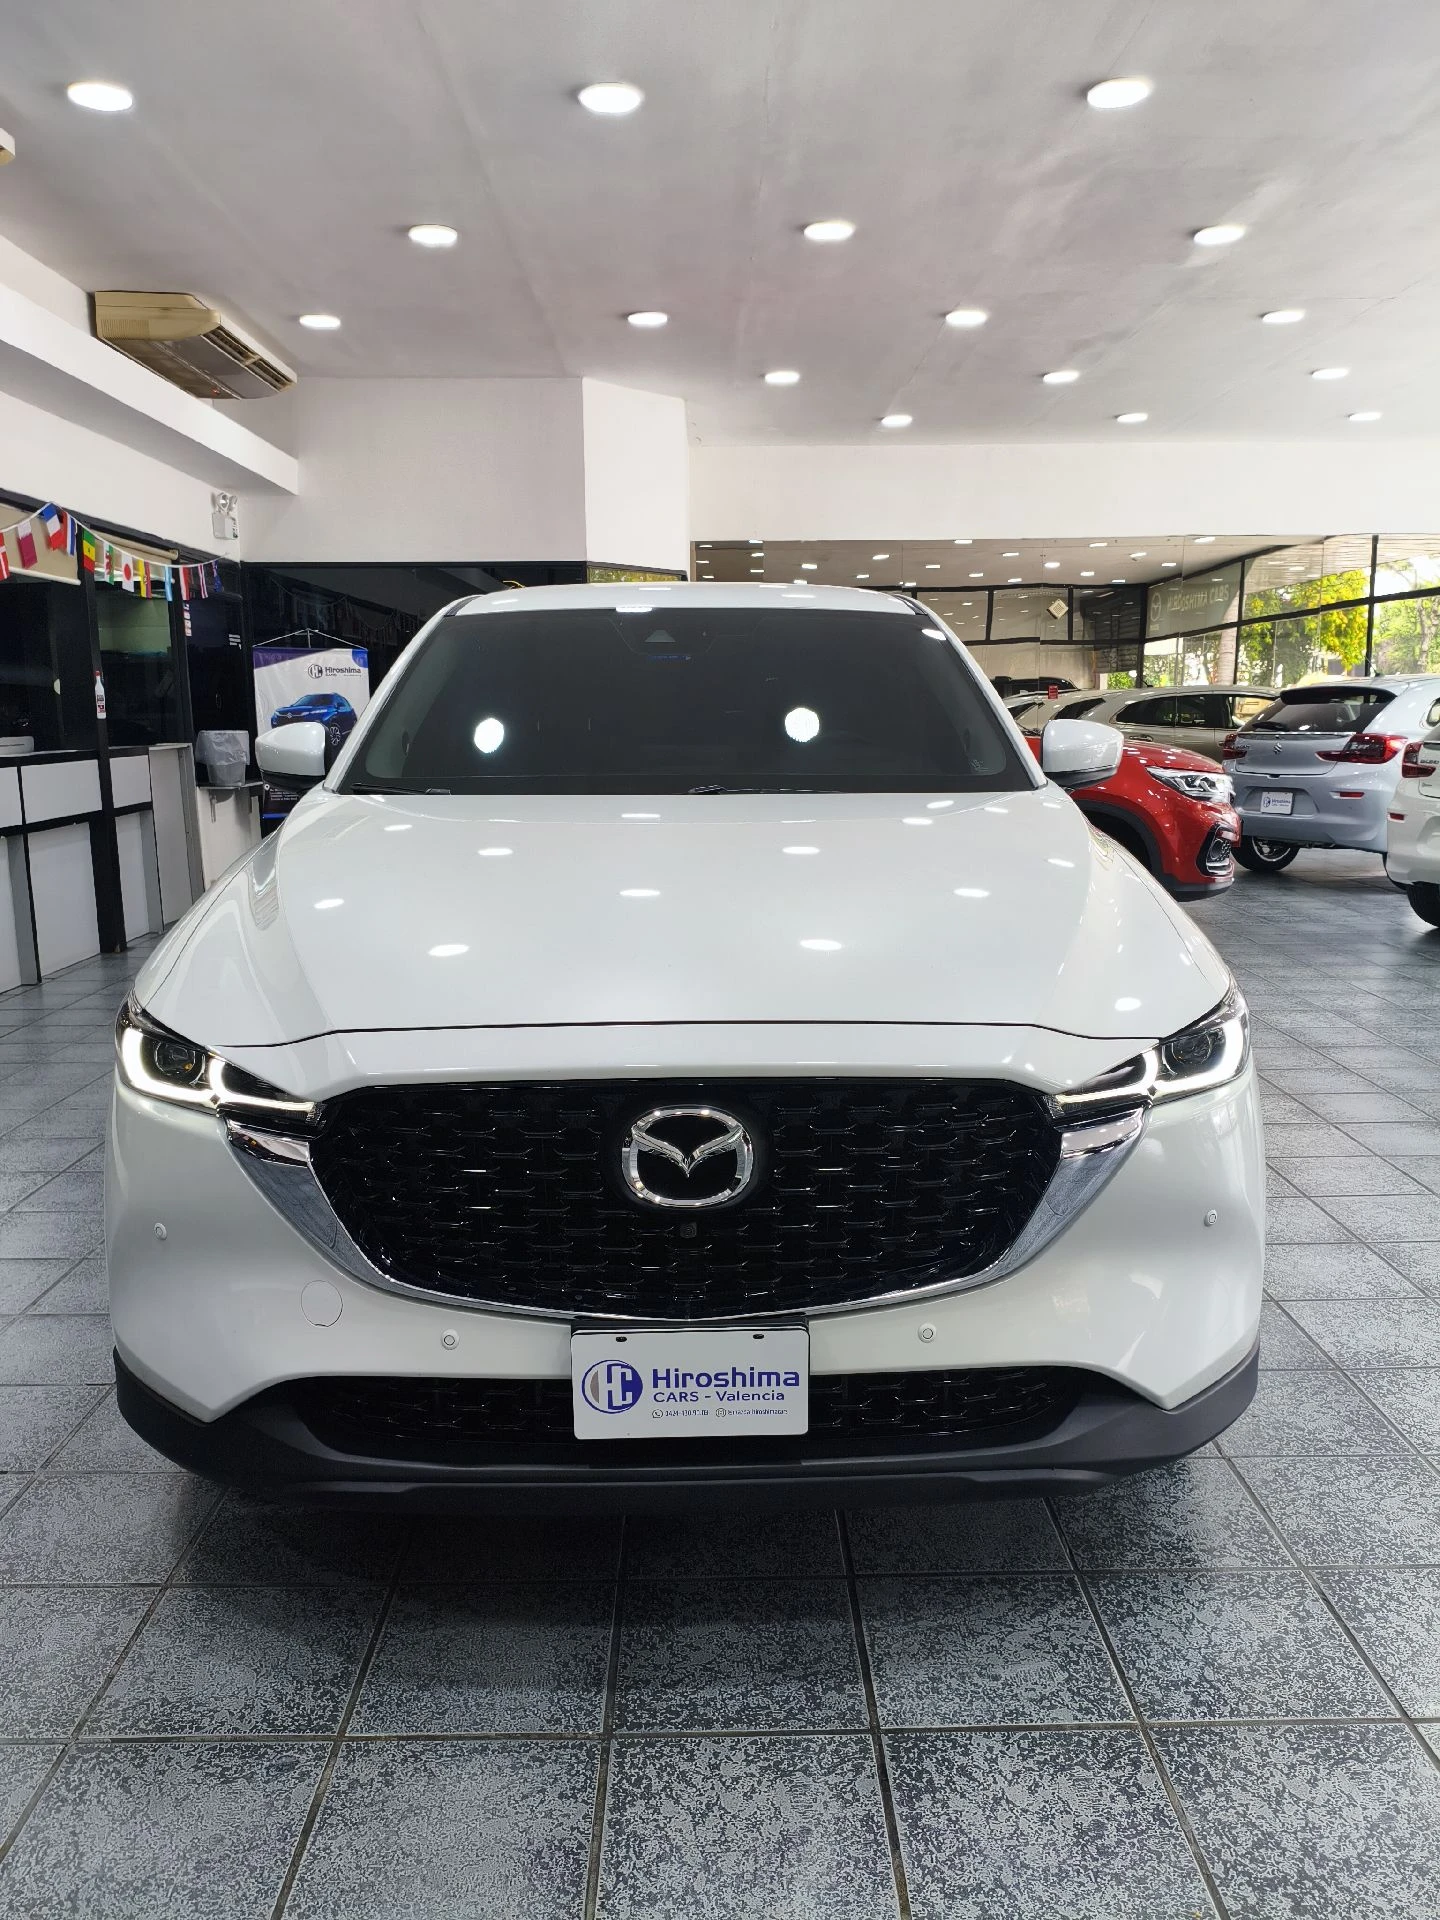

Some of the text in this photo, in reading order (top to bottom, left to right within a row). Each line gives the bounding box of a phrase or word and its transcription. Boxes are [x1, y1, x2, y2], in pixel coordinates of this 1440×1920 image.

[652, 1367, 800, 1389] Hiroshima
[653, 1391, 700, 1403] CARS
[716, 1390, 785, 1402] Valencia
